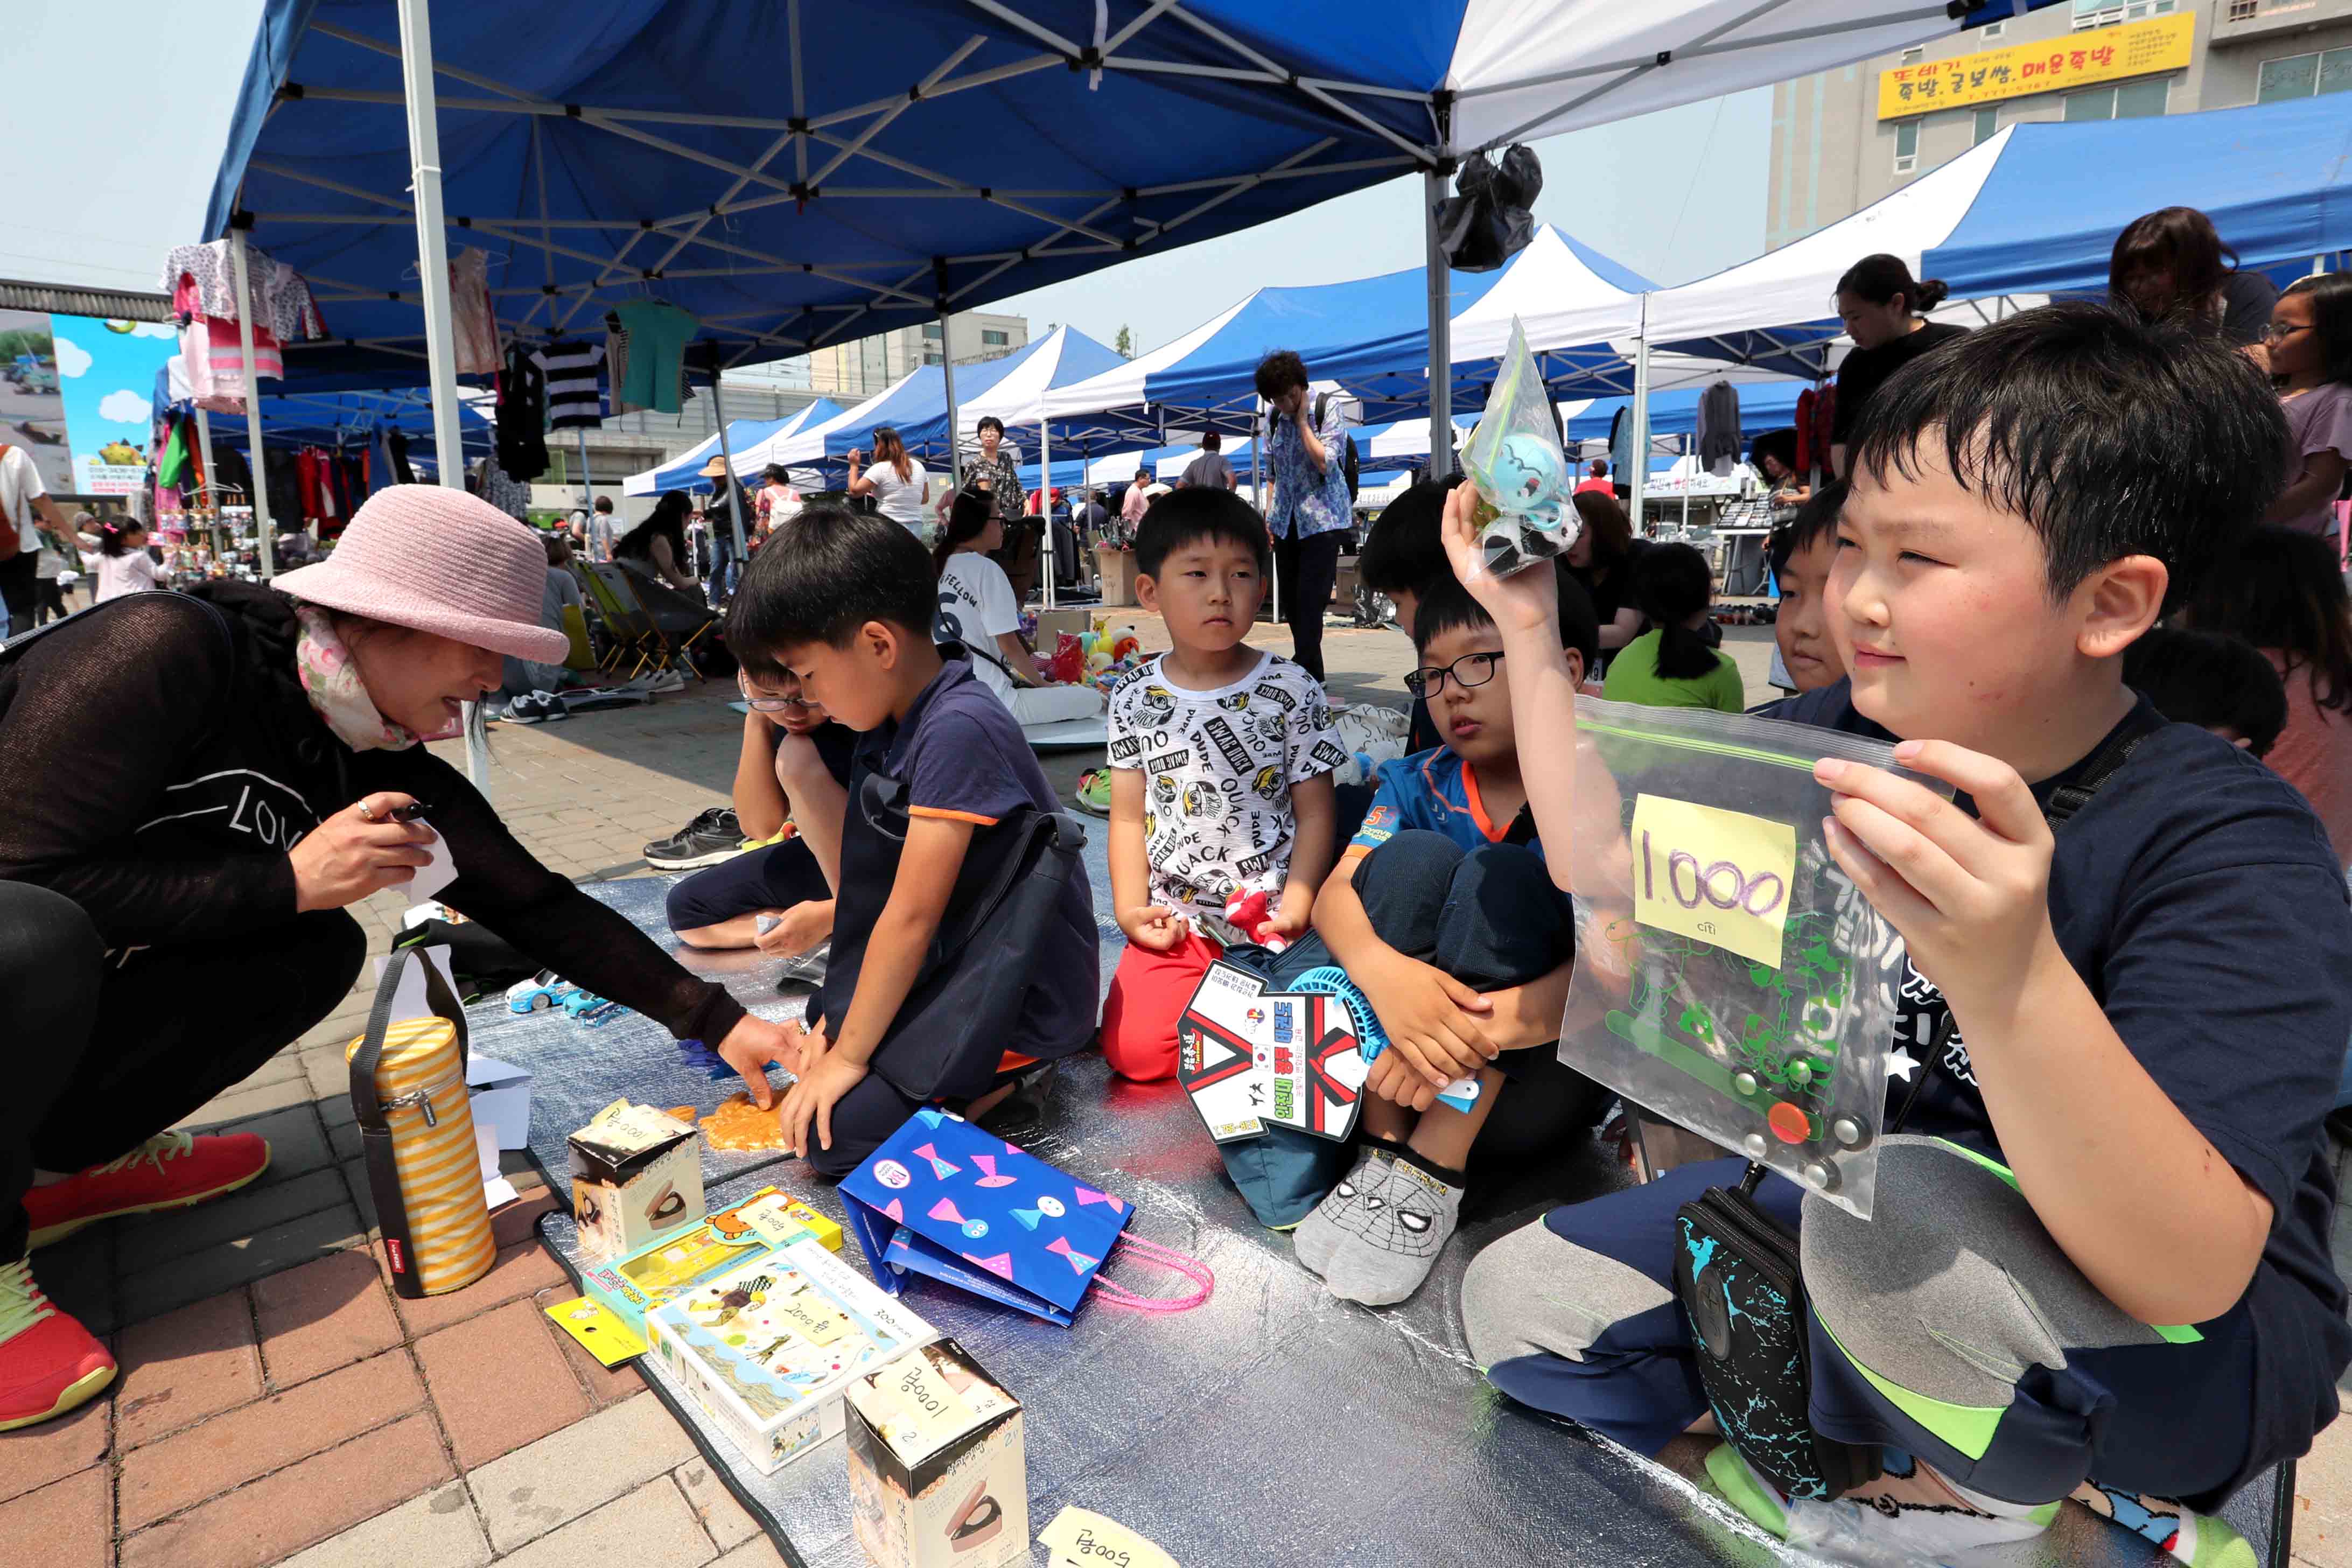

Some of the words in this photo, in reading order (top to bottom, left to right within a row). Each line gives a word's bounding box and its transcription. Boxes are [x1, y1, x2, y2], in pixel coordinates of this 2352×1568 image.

[1208, 720, 1237, 750] SWAG
[1227, 747, 1253, 772] DUCK
[1242, 707, 1266, 752] QUACK
[1167, 752, 1188, 768] SWAG
[1189, 730, 1214, 774] DUDE
[1316, 743, 1344, 768] SWAG
[229, 785, 304, 852] LOV
[1220, 778, 1245, 838] QUACK
[1251, 810, 1266, 850] DUDE
[1176, 845, 1231, 876] UACK
[1696, 921, 1717, 936] citi
[1273, 1001, 1293, 1044] 태권도
[1274, 1078, 1293, 1119] 인천대
[900, 1366, 949, 1419] 1000원
[1076, 1528, 1130, 1568] 500원
